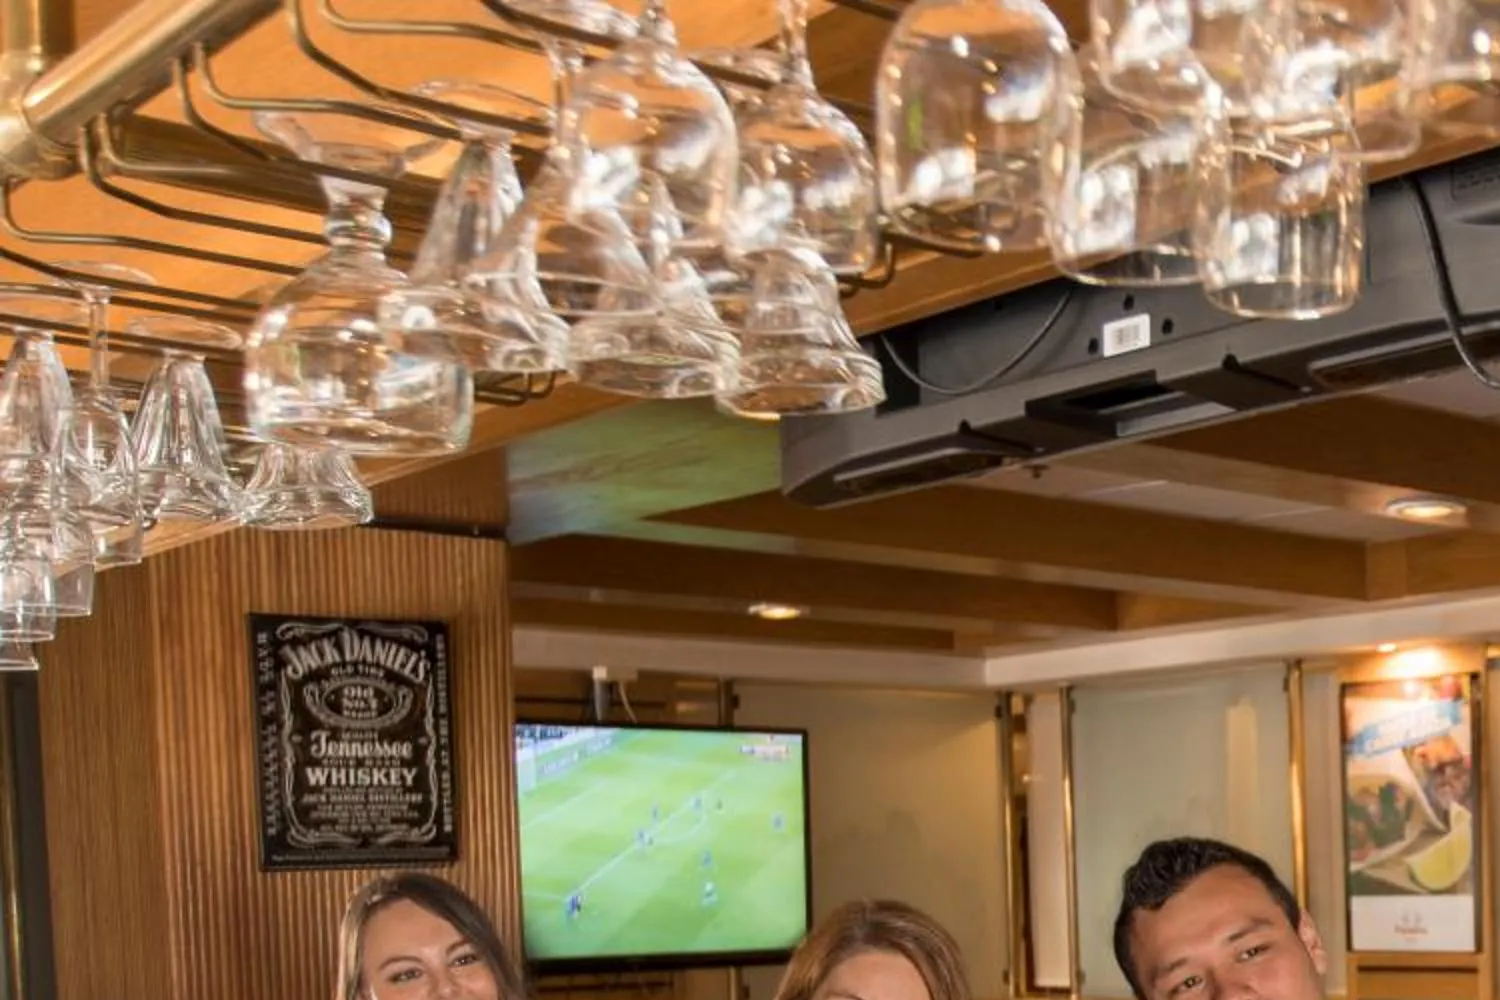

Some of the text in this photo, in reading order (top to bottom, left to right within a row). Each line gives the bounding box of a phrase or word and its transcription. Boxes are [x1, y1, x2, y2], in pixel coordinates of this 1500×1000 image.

[279, 625, 431, 683] JACK DANIEL'S
[342, 685, 375, 699] Old
[309, 729, 413, 759] Tennessee
[305, 766, 419, 787] WHISKEY
